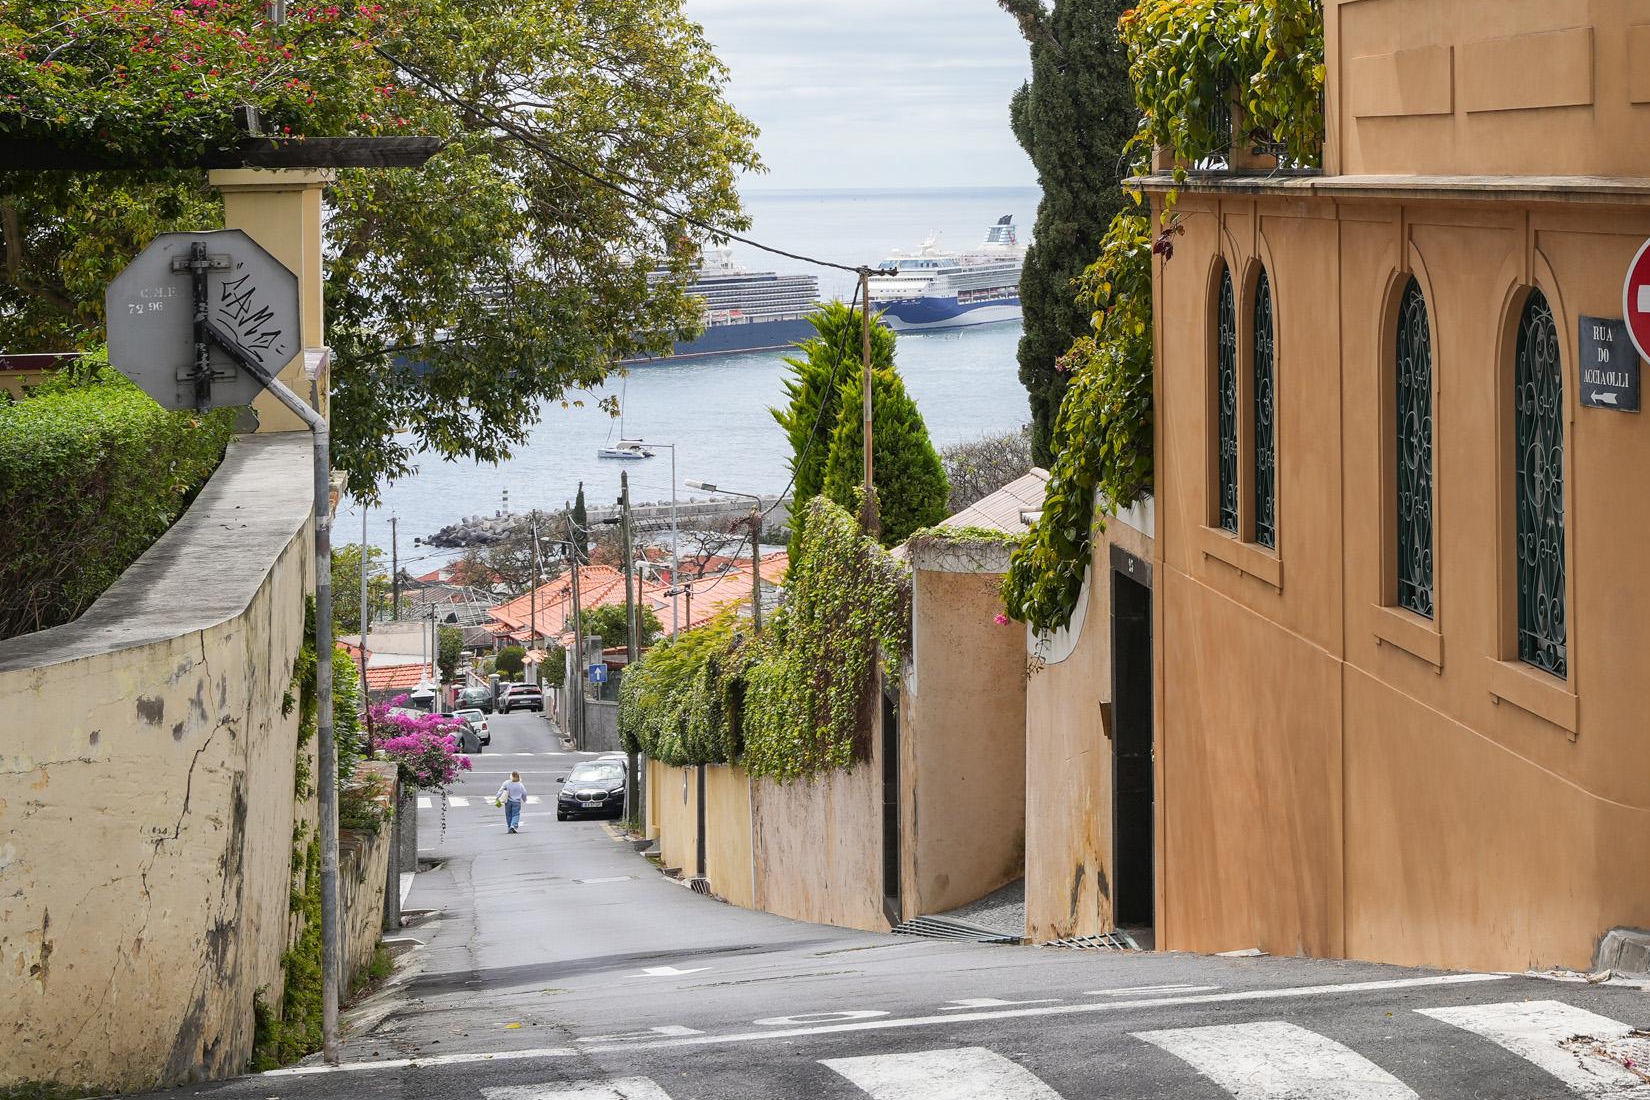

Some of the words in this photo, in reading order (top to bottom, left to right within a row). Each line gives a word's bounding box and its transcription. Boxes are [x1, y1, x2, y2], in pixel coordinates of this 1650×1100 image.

[1592, 325, 1613, 342] RUA
[1597, 347, 1609, 363] DO
[1583, 369, 1629, 388] ACCIAOLLI
